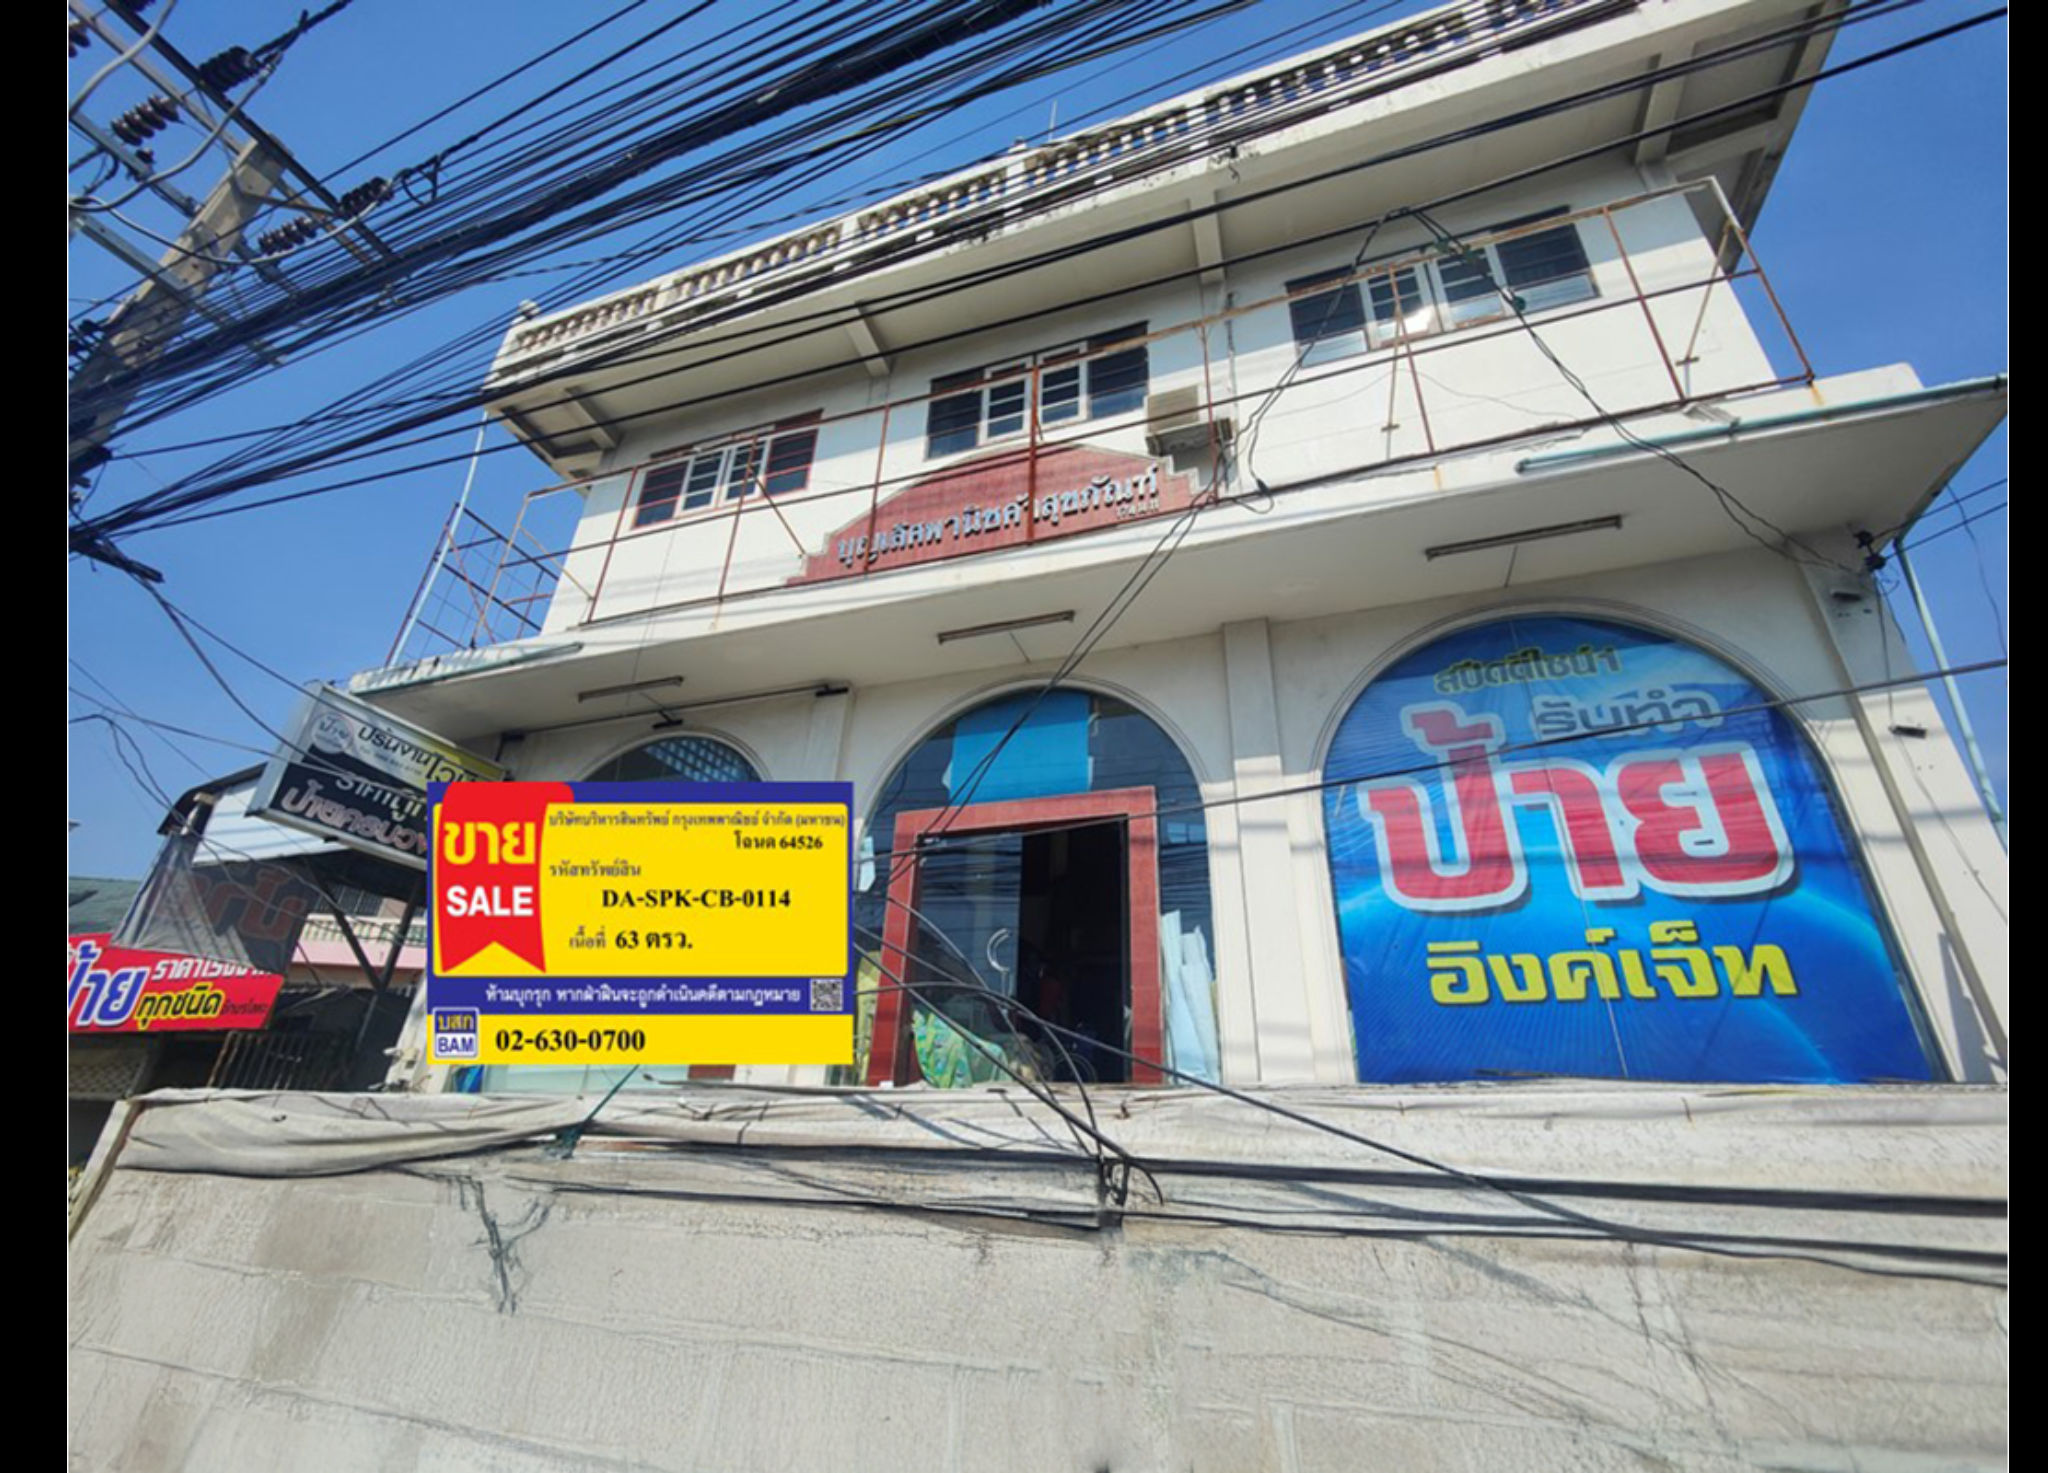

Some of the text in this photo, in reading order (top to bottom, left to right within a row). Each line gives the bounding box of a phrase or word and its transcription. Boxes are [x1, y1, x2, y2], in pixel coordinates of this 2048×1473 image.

[1534, 688, 1720, 736] รับทำ
[1357, 703, 1793, 911] ป้าย
[1426, 921, 1798, 1004] อิงค์เจ็ท
[134, 981, 227, 1031] ทุกชนิด
